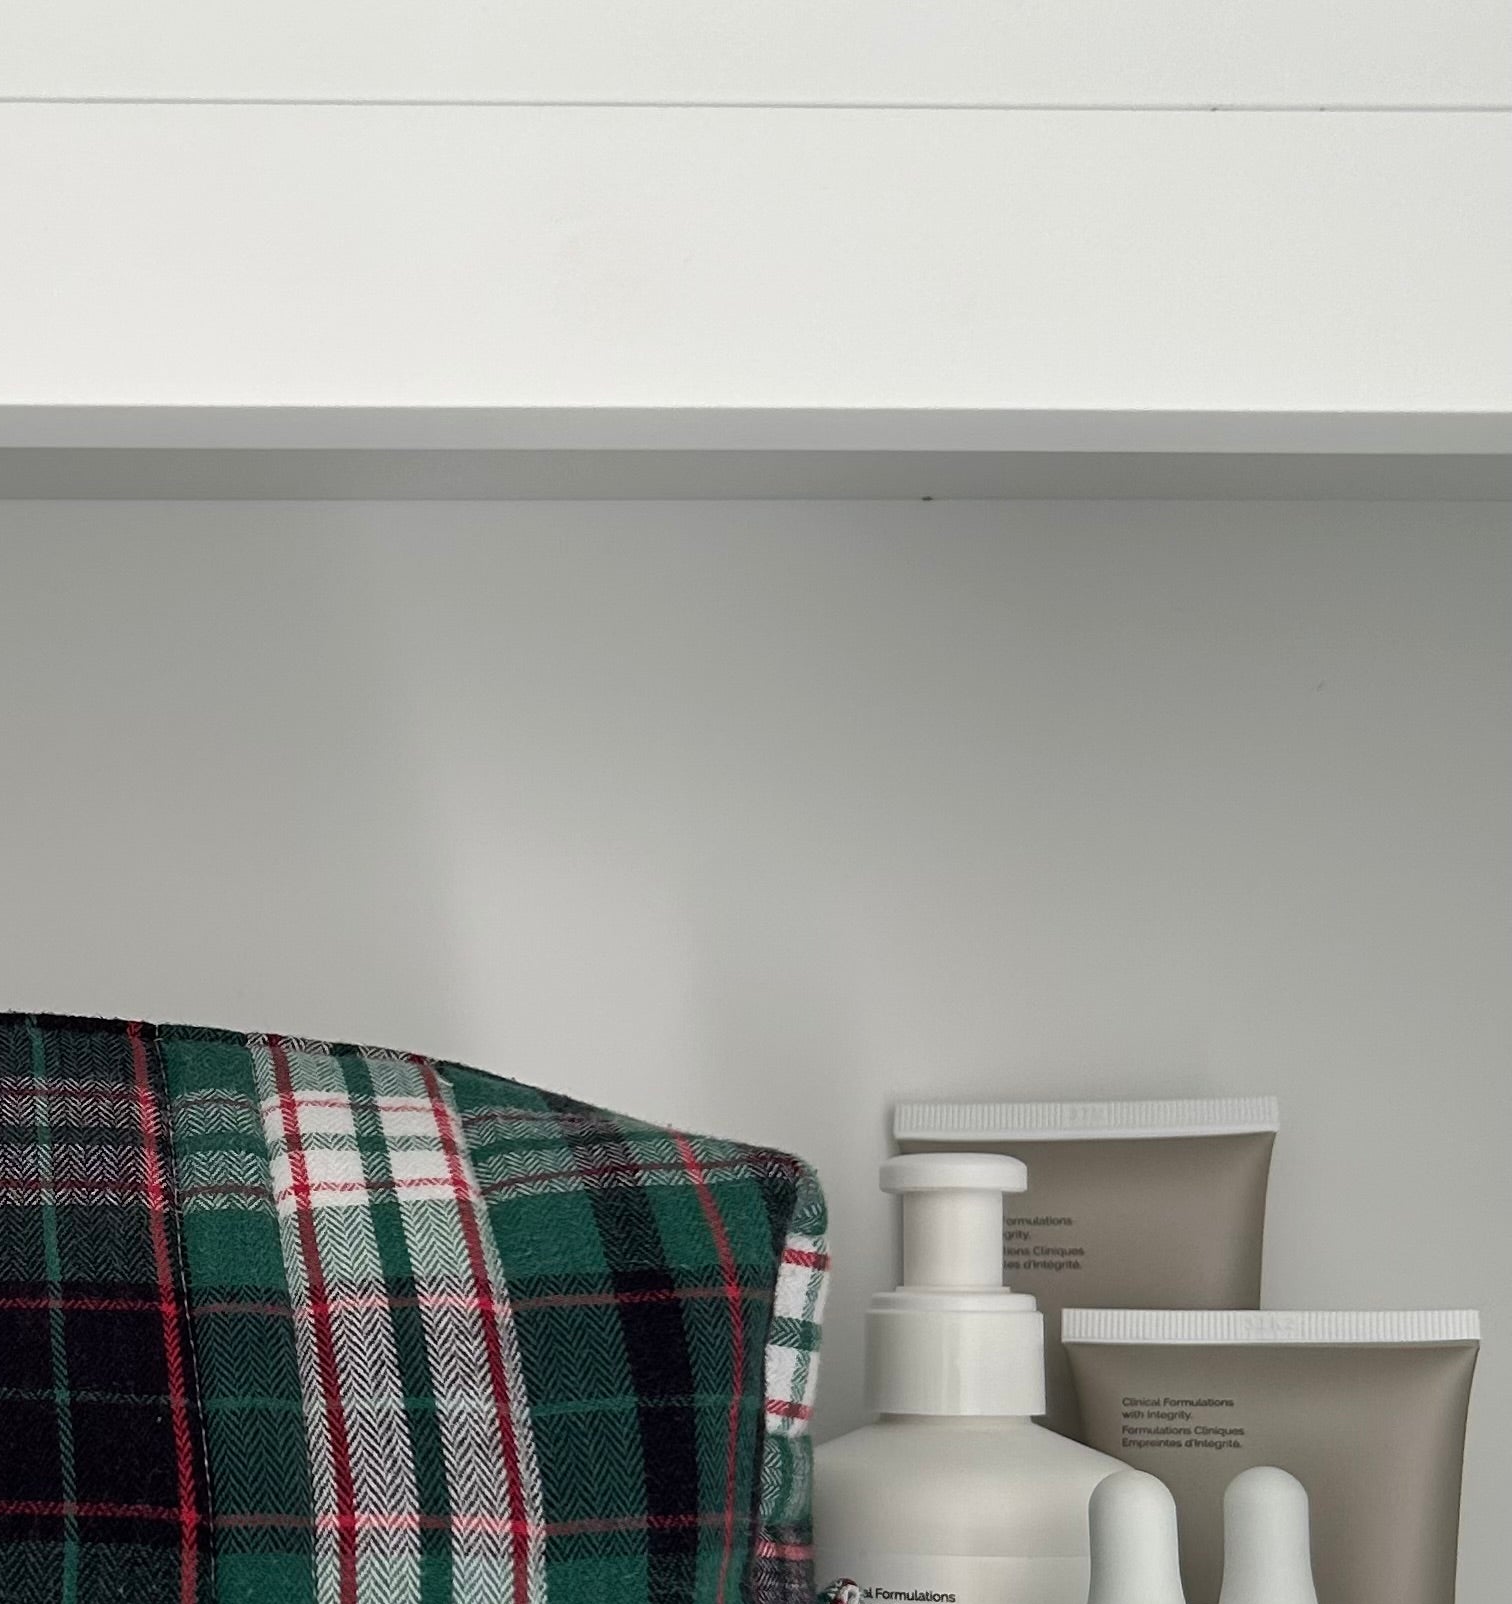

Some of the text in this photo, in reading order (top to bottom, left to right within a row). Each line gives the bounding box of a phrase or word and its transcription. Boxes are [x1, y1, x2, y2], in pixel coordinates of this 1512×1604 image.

[1122, 1397, 1234, 1407] Clinical Formulations
[1122, 1410, 1144, 1420] with
[1122, 1425, 1245, 1437] Formulations Cliniques
[1122, 1438, 1182, 1449] Empreintes
[875, 1588, 957, 1603] Formulations
